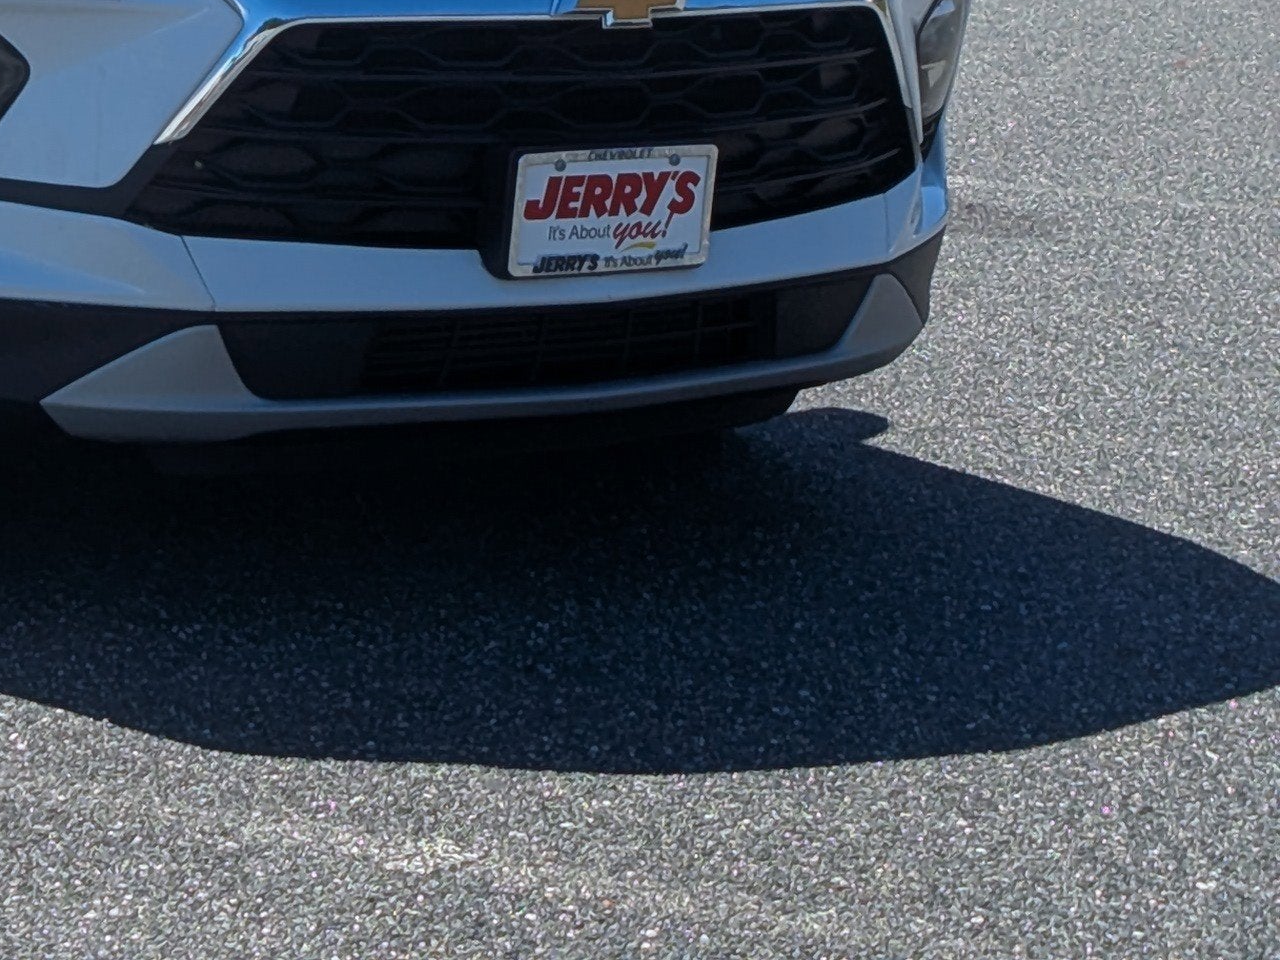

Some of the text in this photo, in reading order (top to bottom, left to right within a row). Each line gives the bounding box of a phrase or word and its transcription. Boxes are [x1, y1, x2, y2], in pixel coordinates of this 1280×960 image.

[523, 170, 701, 220] JERRY'S
[548, 212, 674, 249] It's About you!
[532, 253, 600, 274] JERRY'S
[604, 256, 619, 268] It's
[620, 254, 654, 268] About
